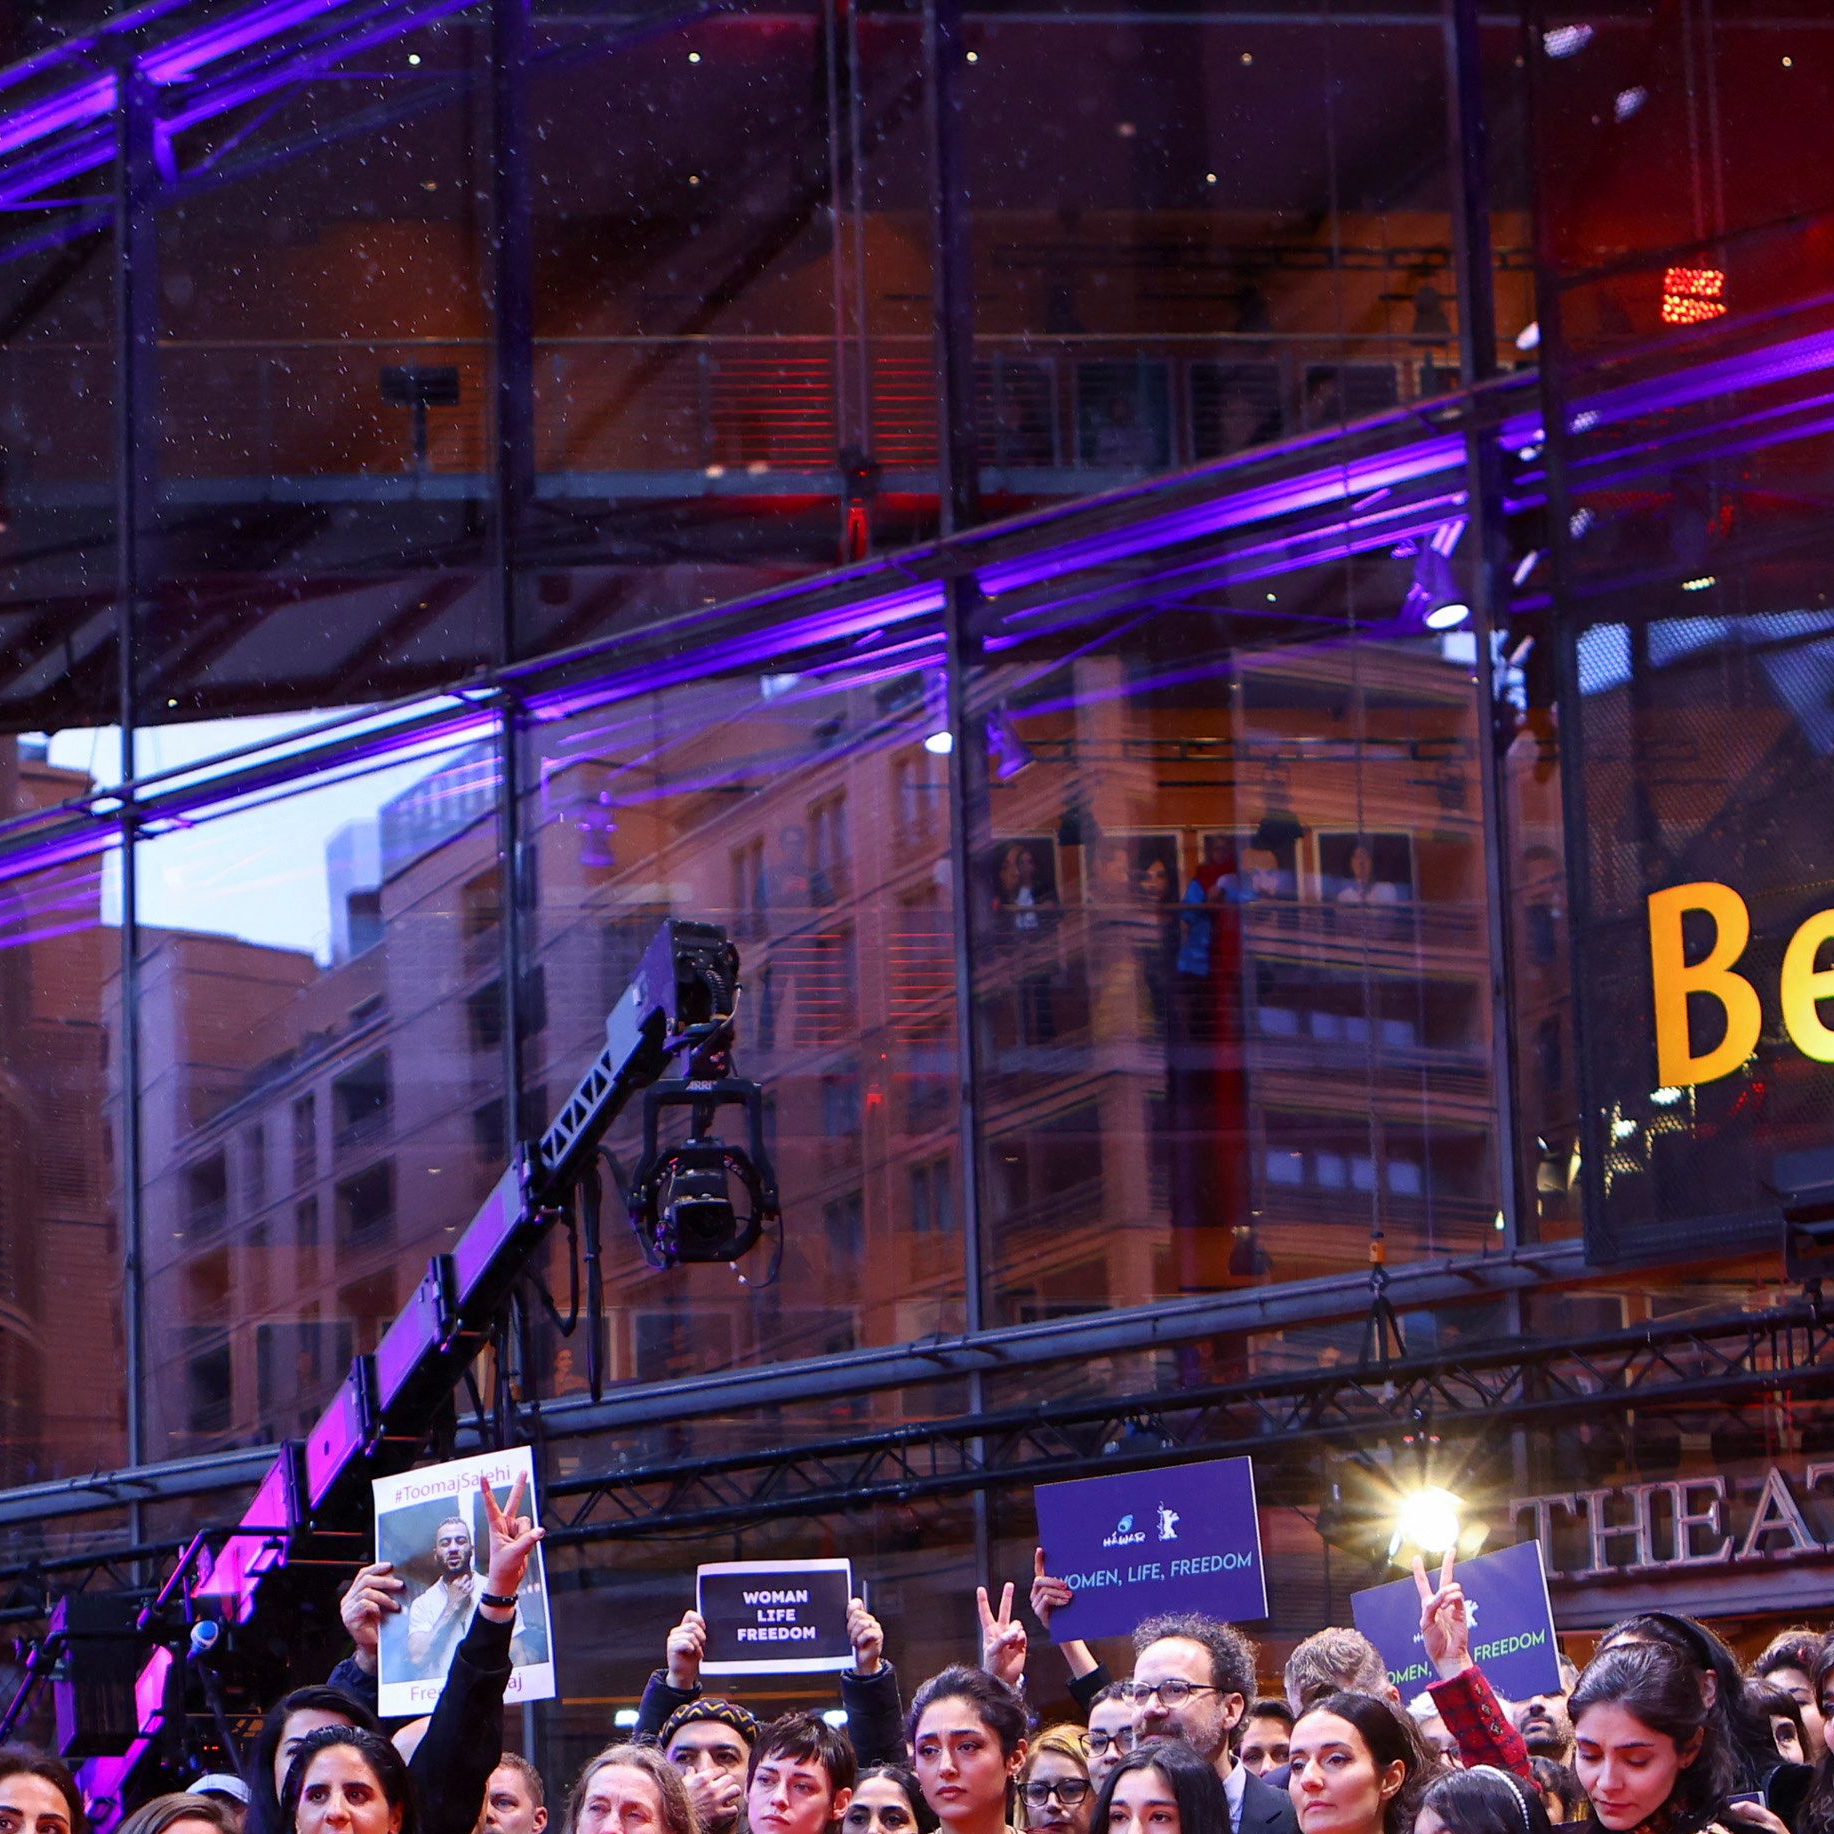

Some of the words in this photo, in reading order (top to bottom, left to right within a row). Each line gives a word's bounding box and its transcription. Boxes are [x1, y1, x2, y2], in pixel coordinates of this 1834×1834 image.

[1054, 1568, 1123, 1591] OMEN,
[1128, 1563, 1165, 1583] LIFE,
[1171, 1551, 1253, 1577] FREEDOM
[743, 1590, 808, 1604] WOMAN
[757, 1609, 796, 1622] LIFE
[737, 1626, 816, 1641] FREEDOM
[1387, 1661, 1433, 1686] OMEN,
[1473, 1629, 1546, 1662] FREEDOM
